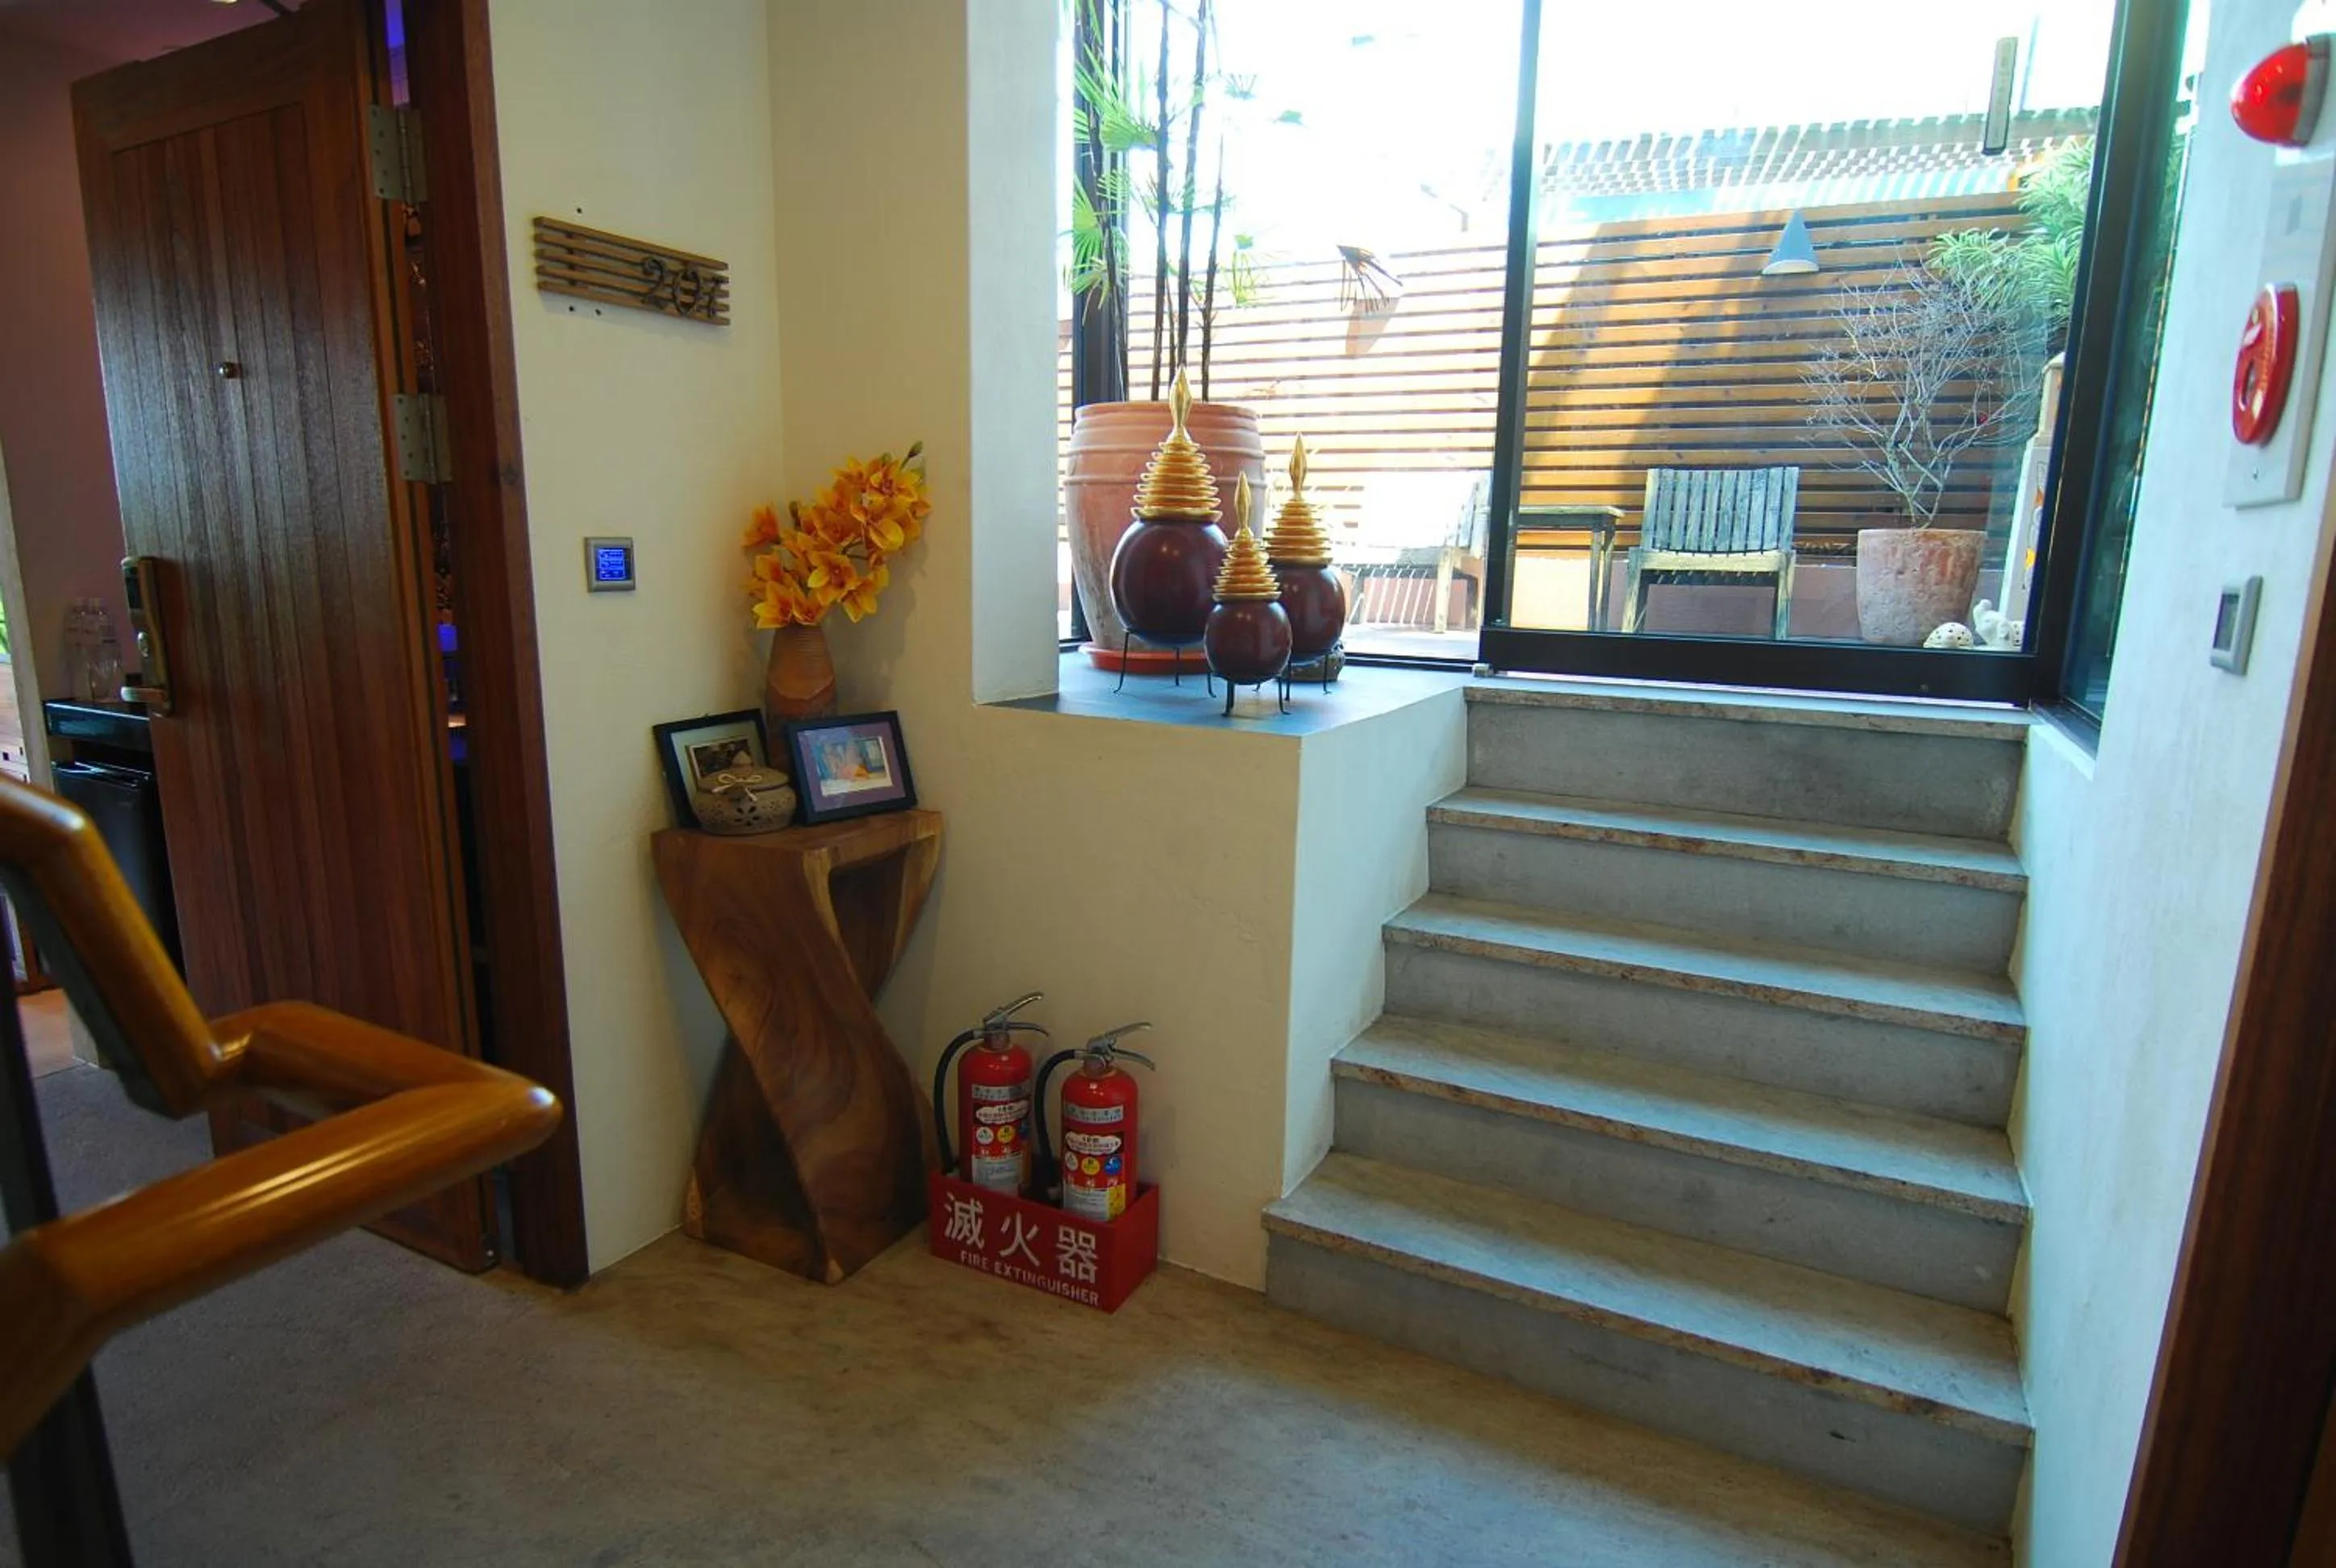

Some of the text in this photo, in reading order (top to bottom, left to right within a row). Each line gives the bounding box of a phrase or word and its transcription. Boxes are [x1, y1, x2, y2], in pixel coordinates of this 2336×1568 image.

[945, 1191, 1098, 1283] 滅火器
[960, 1250, 1099, 1307] FIRE EXTINGUISHER
